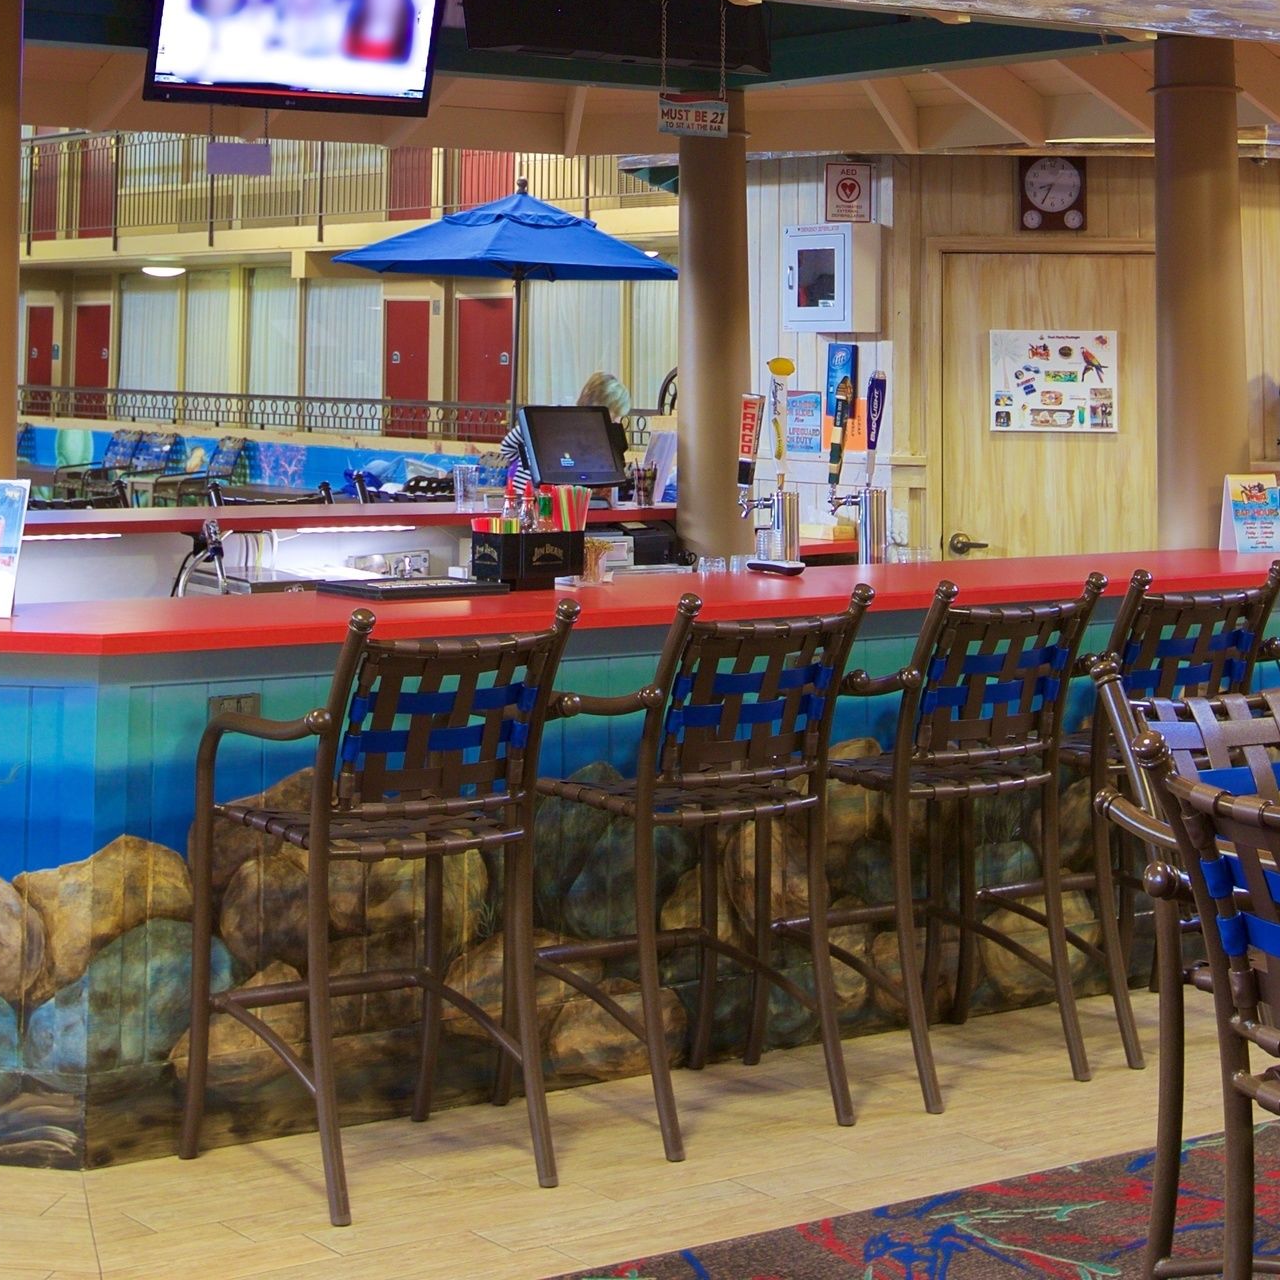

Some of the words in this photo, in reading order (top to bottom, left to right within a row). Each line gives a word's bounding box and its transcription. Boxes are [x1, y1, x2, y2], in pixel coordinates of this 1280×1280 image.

[661, 108, 690, 121] MUST
[694, 110, 708, 123] BE
[710, 111, 725, 125] 21
[840, 168, 857, 176] AED
[741, 400, 757, 454] FARGO
